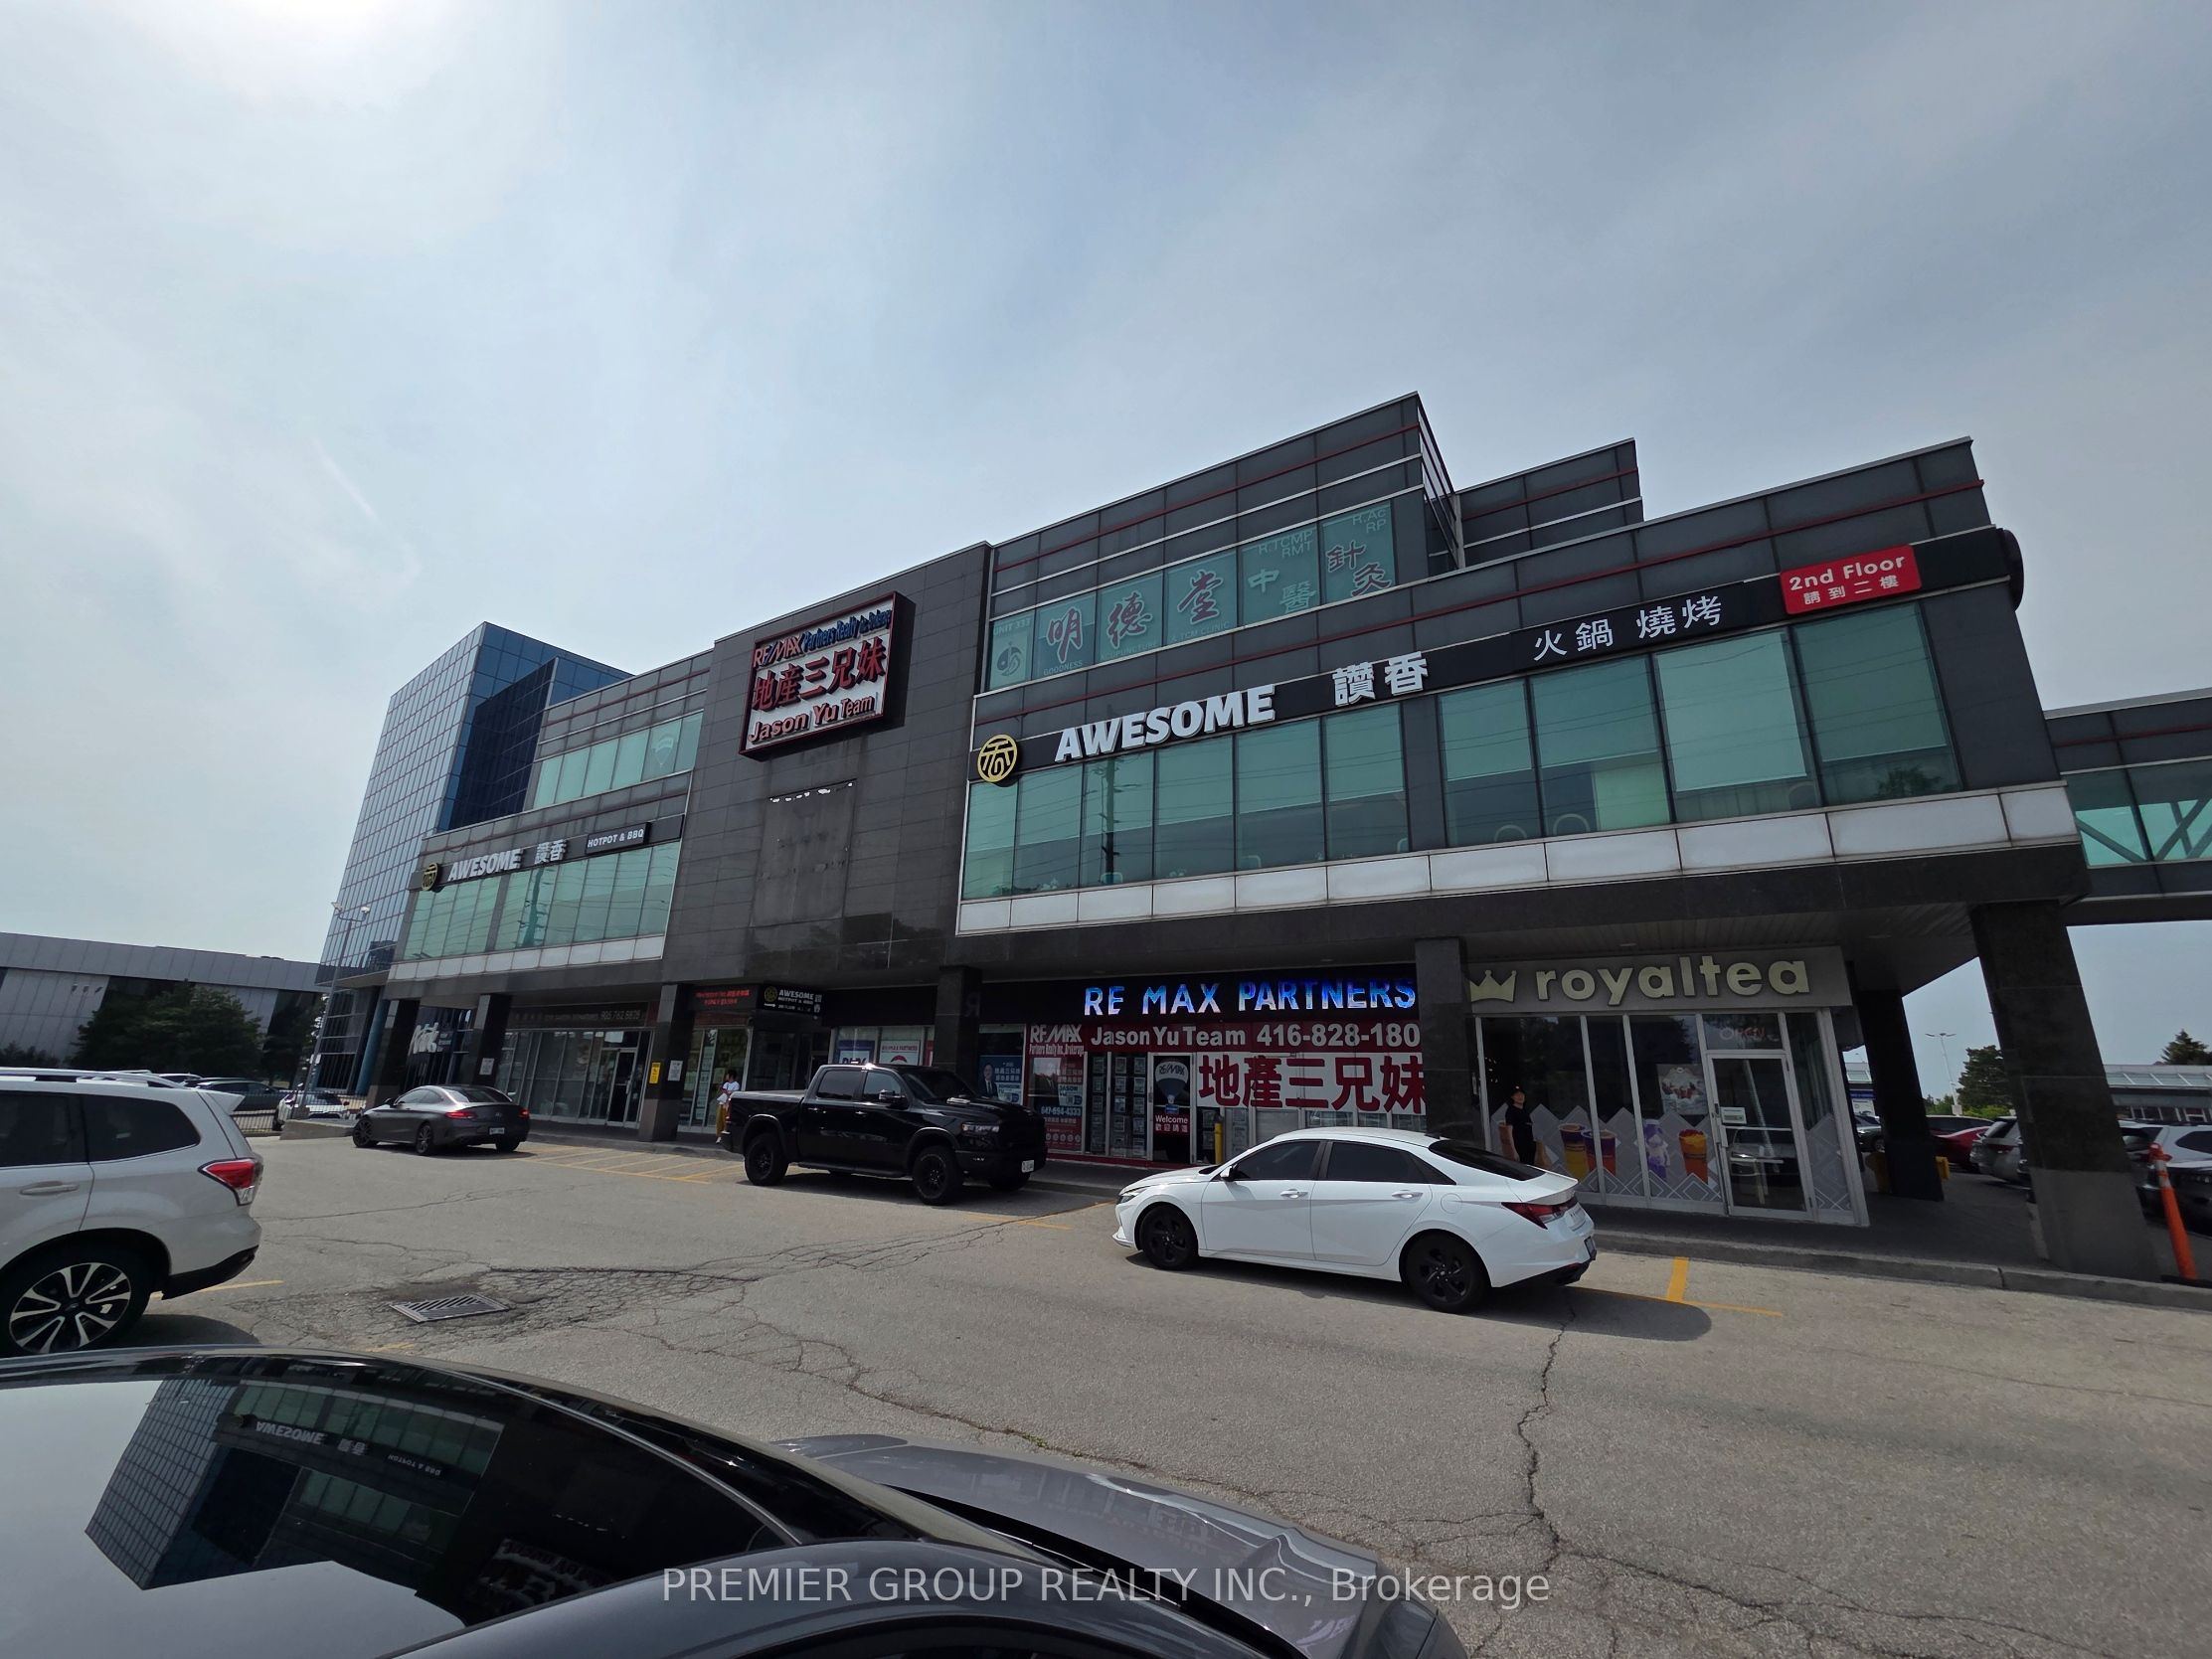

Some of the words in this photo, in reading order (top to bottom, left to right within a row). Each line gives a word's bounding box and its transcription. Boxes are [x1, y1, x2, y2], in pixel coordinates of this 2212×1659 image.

[1281, 541, 1313, 558] RMT
[1789, 568, 1834, 590] 2nd
[1842, 556, 1905, 580] Floor
[1533, 621, 1614, 662] 火鍋
[1635, 594, 1723, 641] 燒烤
[1043, 659, 1084, 676] GOODNESS
[748, 712, 809, 743] Jason
[812, 702, 839, 726] Yu
[840, 695, 874, 719] Team
[1055, 683, 1276, 762] AWESOME
[447, 848, 524, 882] AWESOME
[588, 833, 618, 849] HOTPOT
[619, 831, 625, 842] &
[627, 828, 645, 841] BBQ
[778, 989, 815, 1001] AWESOME
[1084, 985, 1125, 1016] RE
[1142, 982, 1222, 1015] MAX
[1237, 978, 1417, 1012] PARTNERS
[1535, 954, 1810, 1007] royaltea
[1091, 1026, 1150, 1046] Jason
[1152, 1026, 1180, 1046] Yu
[1182, 1025, 1246, 1047] Team
[1198, 1054, 1427, 1114] 地產三兄妹
[1154, 1114, 1189, 1124] Welcome
